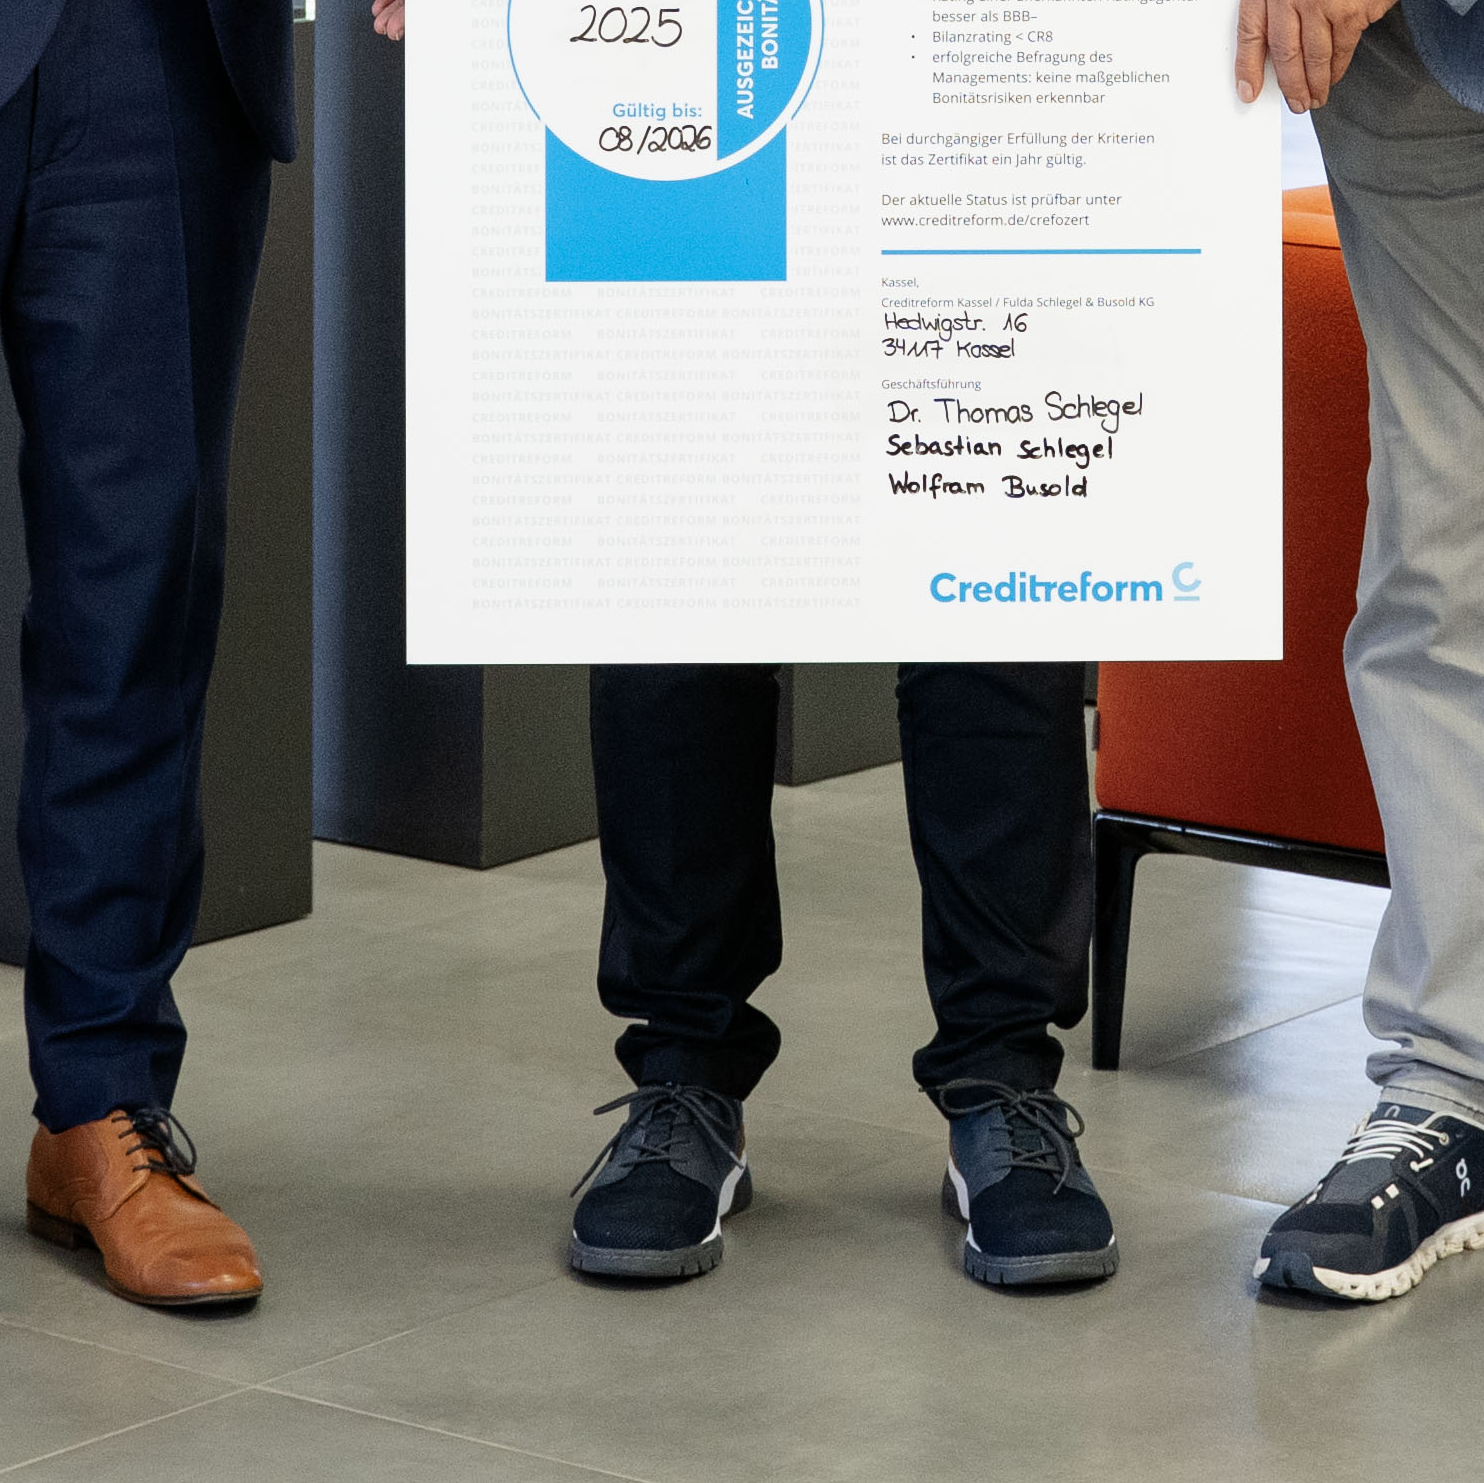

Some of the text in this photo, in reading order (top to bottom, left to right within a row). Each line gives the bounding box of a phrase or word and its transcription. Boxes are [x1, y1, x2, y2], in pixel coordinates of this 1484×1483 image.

[932, 9, 977, 23] besser
[980, 9, 999, 23] als
[569, 4, 683, 48] 2025
[932, 30, 1013, 46] Bilanzrating
[1027, 28, 1054, 43] CR8
[932, 50, 1114, 67] erfolgreiche Befragung des
[932, 70, 1170, 87] Managements: keine maßgeblichen
[932, 91, 1107, 105] Bonitätsrisiken erkennbar
[612, 102, 702, 122] Gültig bis:
[598, 124, 713, 156] 08/2026
[881, 131, 1155, 148] Bei durchgängiger Erfüllung der Kriterien
[881, 152, 1087, 169] ist das Zertifikat ein Jahr gültig.
[881, 192, 1123, 209] Der aktuelle Status ist prüfbar unter
[880, 213, 1091, 227] www.creditreform.de/crefozert
[881, 276, 920, 289] Kassel,
[881, 296, 954, 308] Creditreform
[957, 296, 993, 308] Kassel
[1003, 296, 1034, 308] Fulda
[1036, 296, 1083, 310] Schlegel
[1097, 296, 1136, 308] Busold
[1138, 296, 1155, 307] KG
[884, 311, 1029, 341] Hedwigstr. 16
[882, 337, 1016, 359] 34117 Kassel
[881, 378, 982, 392] Geschäftsführung
[887, 390, 1144, 434] Dr. Thomas Schlegel
[885, 434, 1114, 470] Sebastian Schlegel
[887, 469, 1088, 500] Wolfram Busold
[929, 569, 1164, 604] Creditreform
